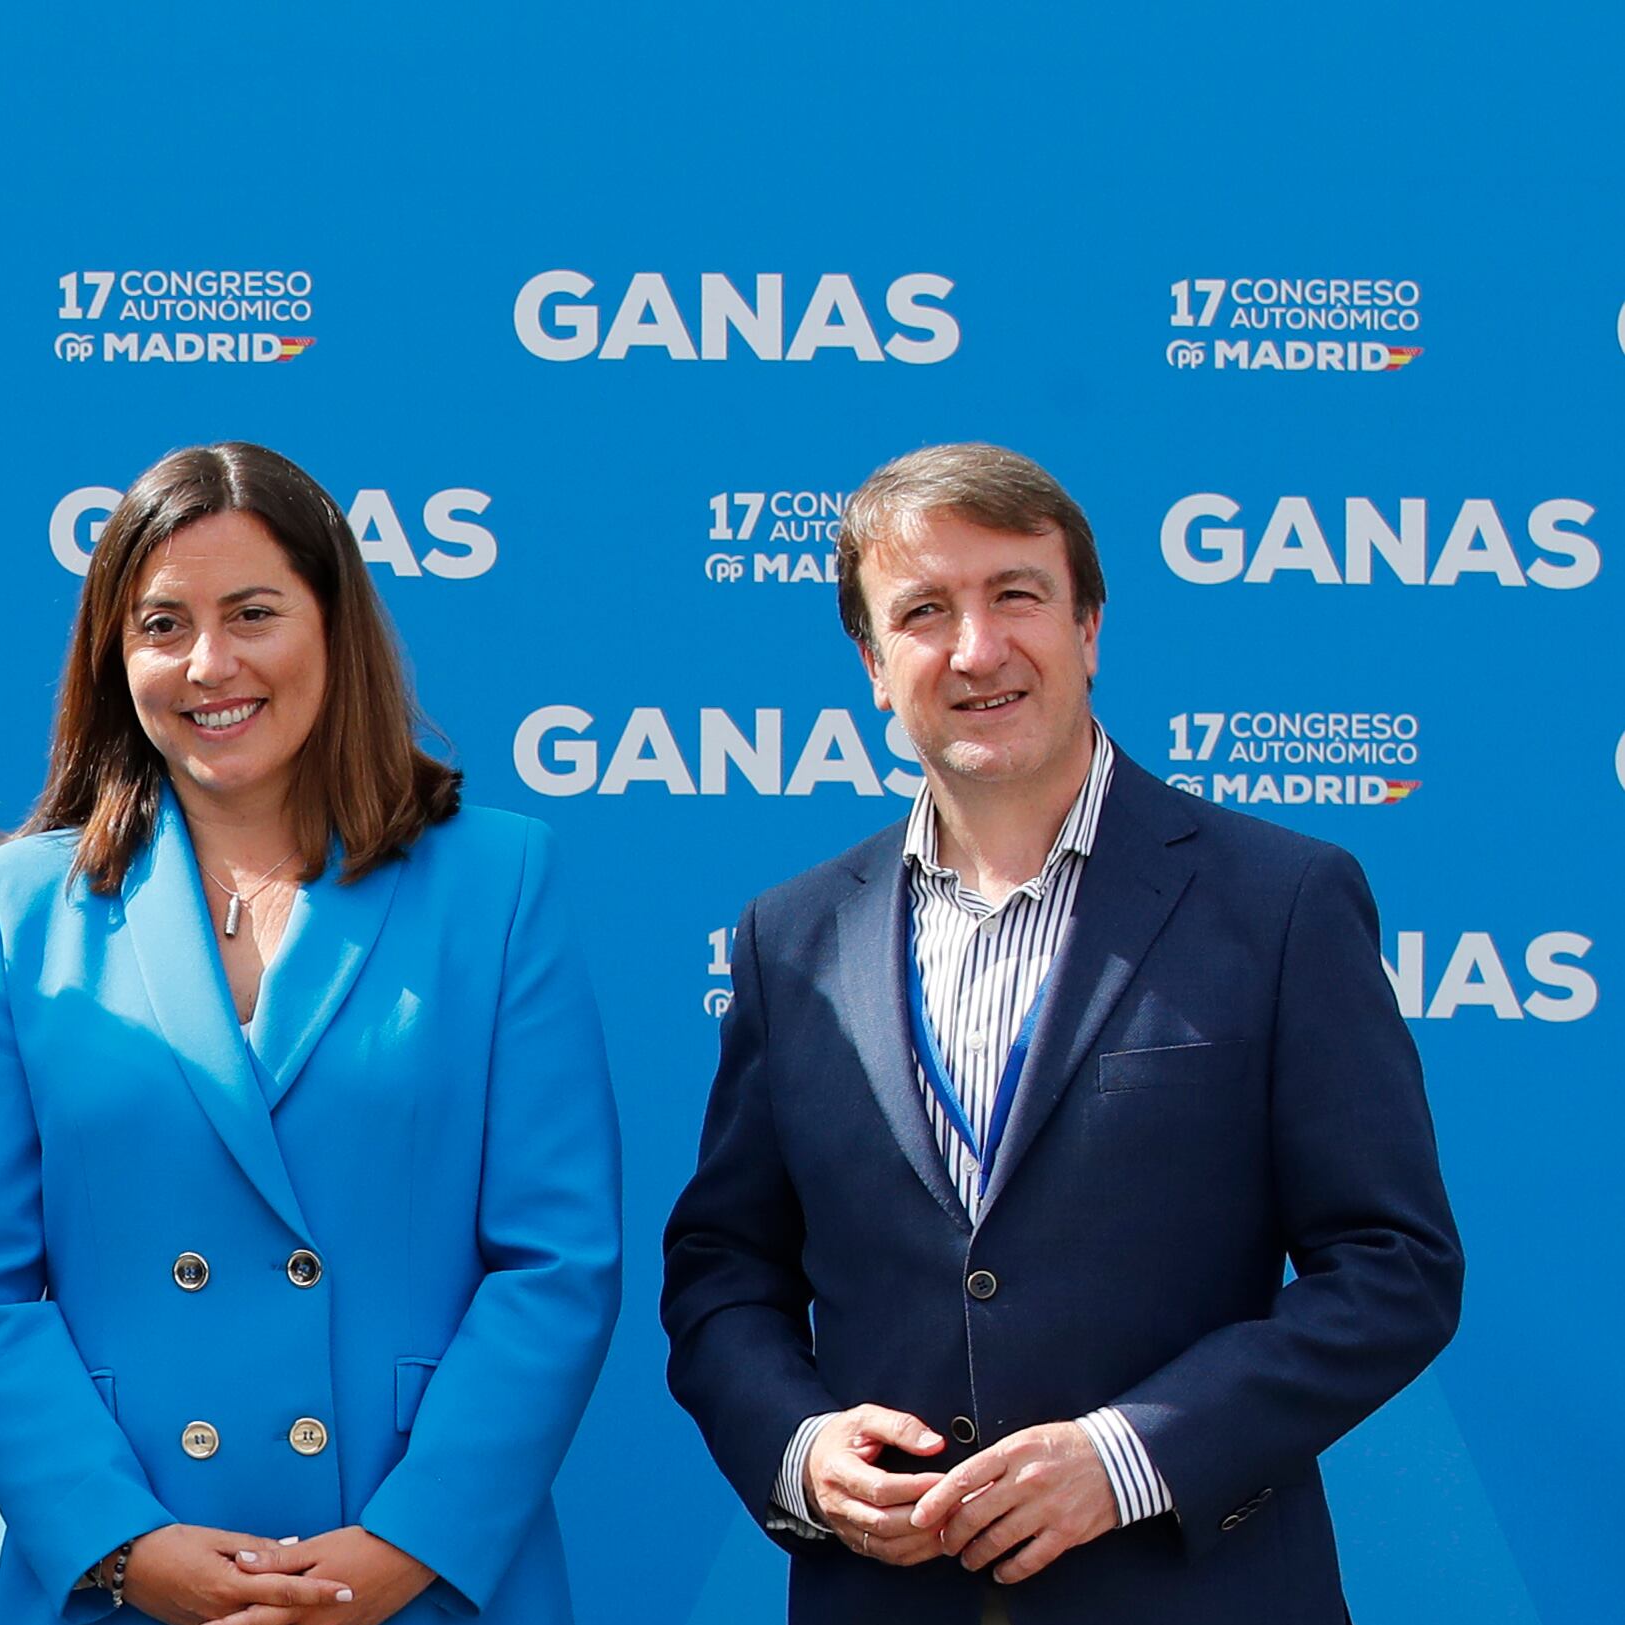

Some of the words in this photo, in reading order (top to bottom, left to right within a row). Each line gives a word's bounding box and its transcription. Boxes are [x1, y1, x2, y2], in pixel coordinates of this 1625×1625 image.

[59, 272, 115, 318] 17
[121, 271, 311, 296] CONGRESO
[121, 296, 311, 320] AUTONÓMICO
[515, 270, 960, 363] GANAS
[1171, 279, 1226, 326] 17
[1232, 279, 1419, 306] CONGRESO
[1231, 305, 1419, 330] AUTONÓMICO
[104, 333, 282, 361] MADRID
[1215, 340, 1390, 370] MADRID
[48, 486, 497, 579] GAS
[709, 492, 765, 540] 17
[1161, 493, 1601, 589] GANAS
[1170, 713, 1224, 760] 17
[1231, 713, 1418, 739] CONGRESO
[1231, 737, 1417, 764] AUTONÓMICO
[1214, 774, 1389, 804] MADRID
